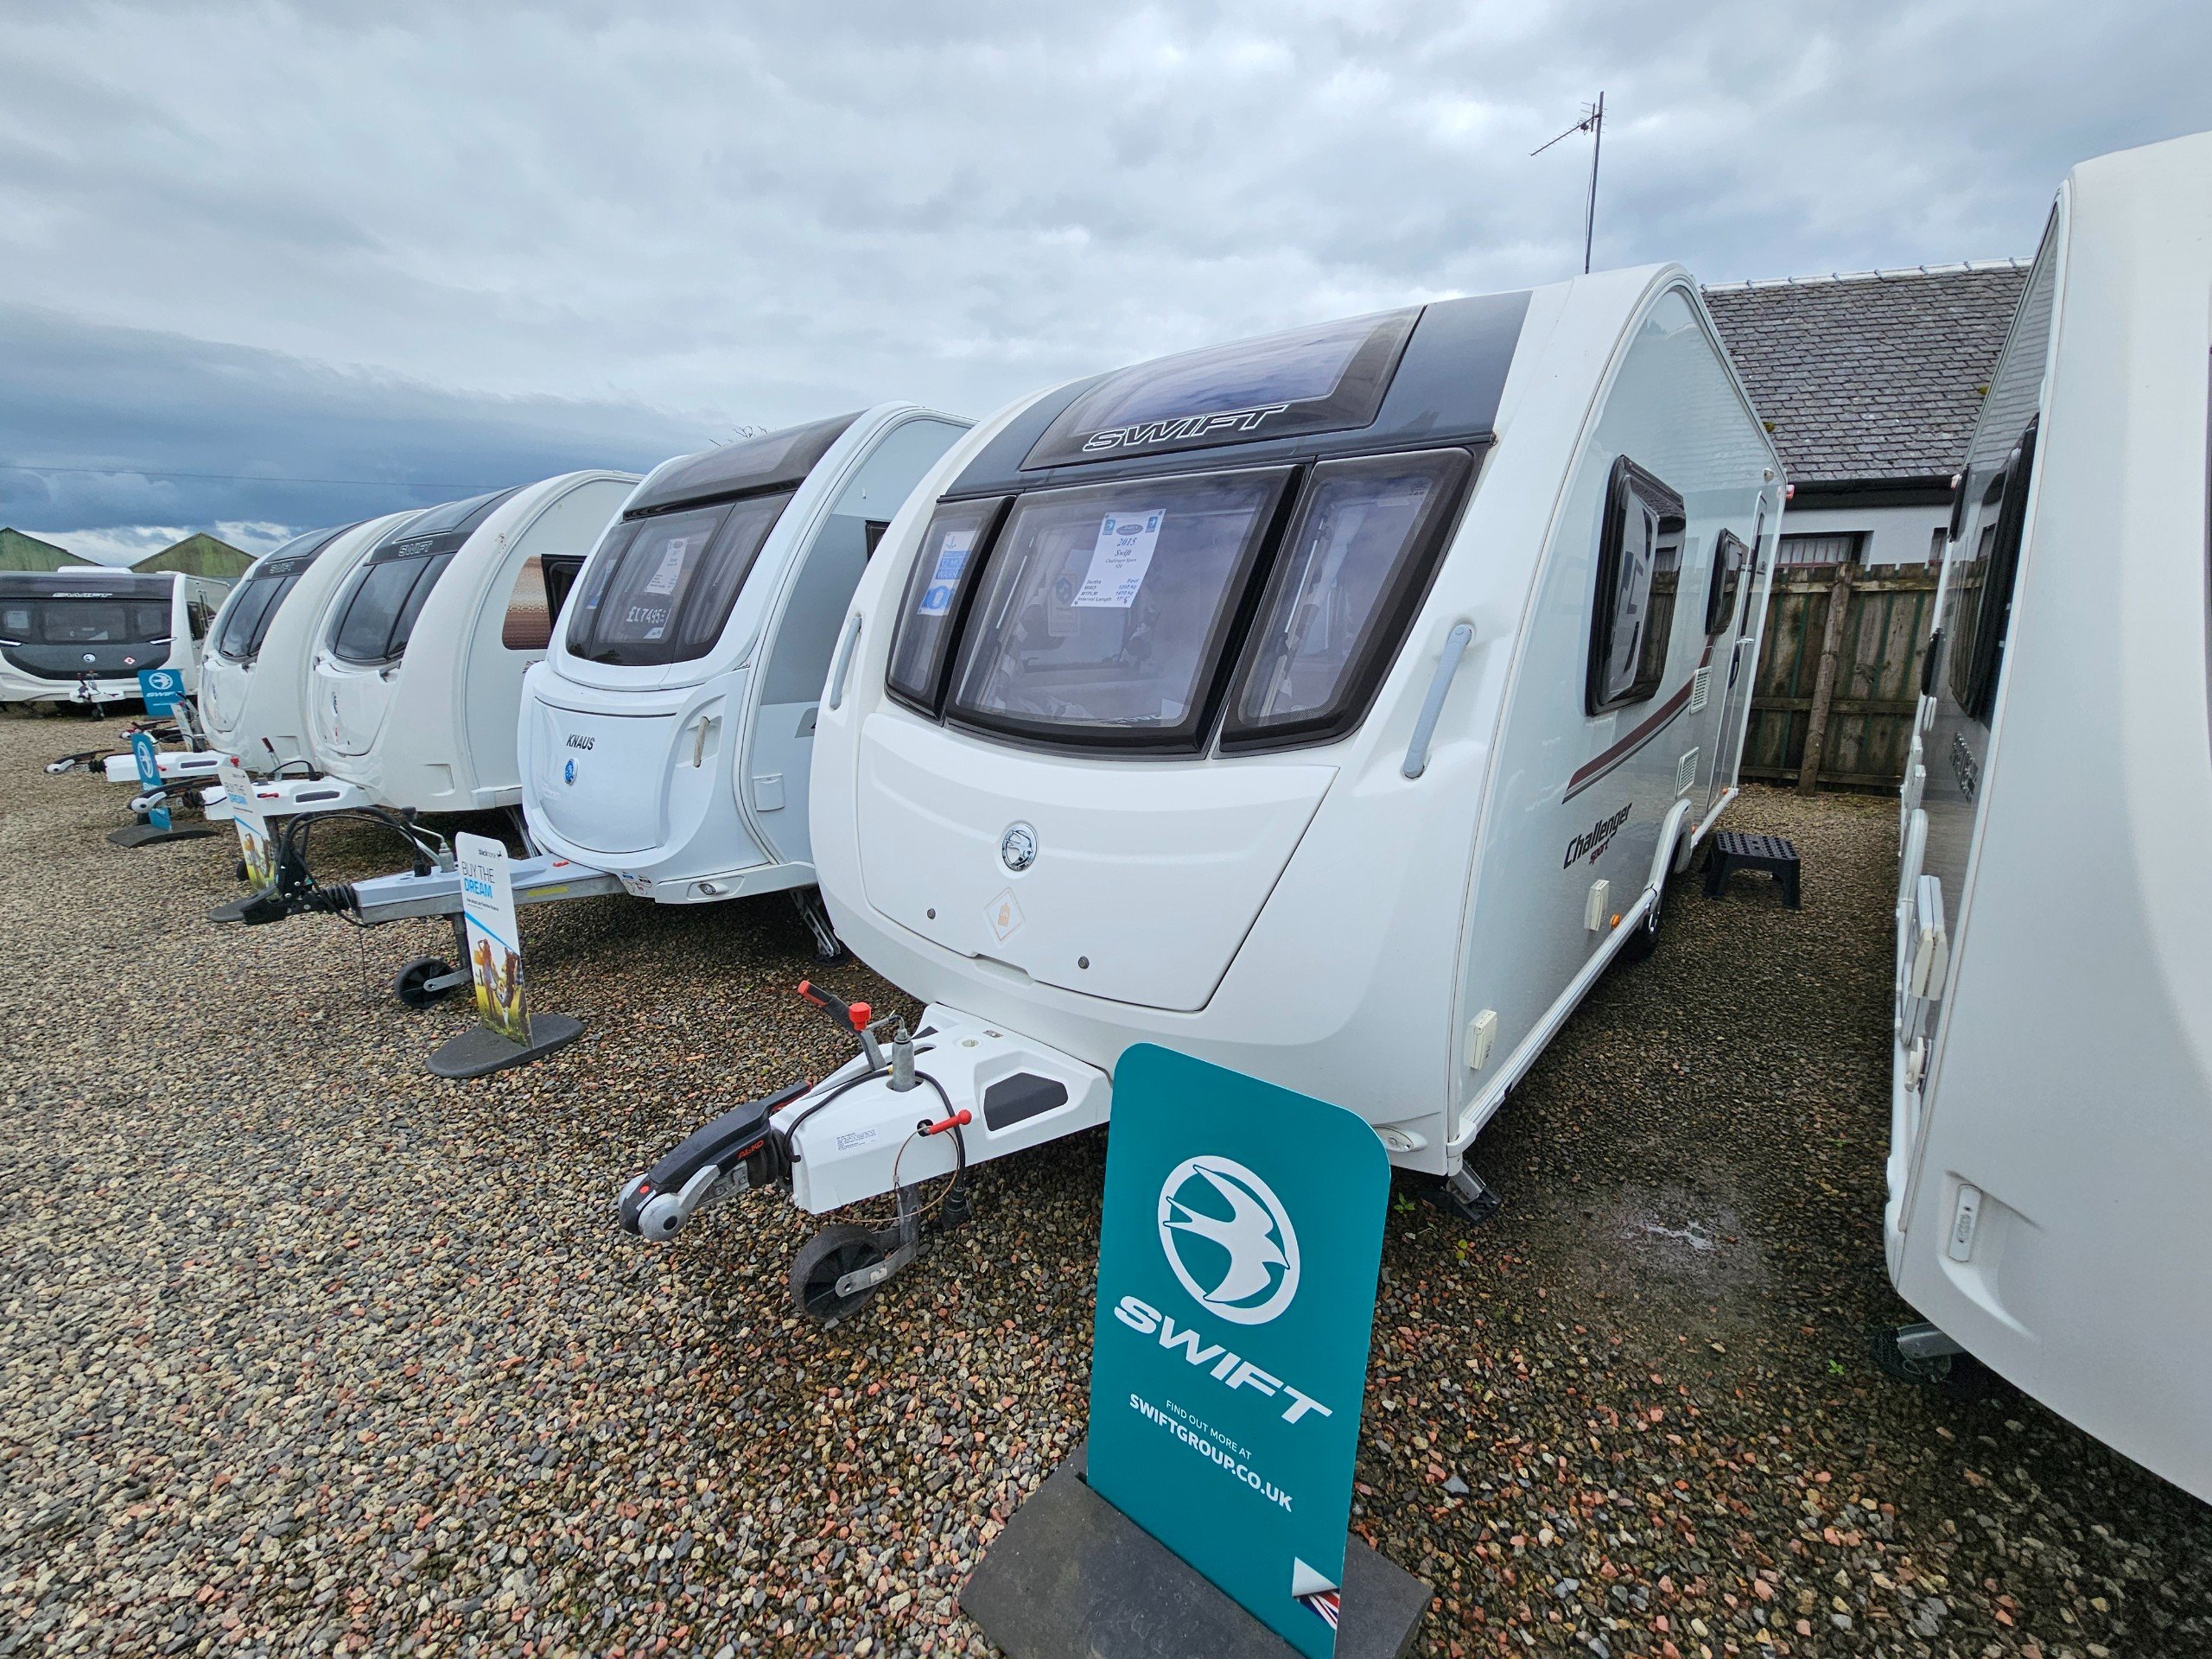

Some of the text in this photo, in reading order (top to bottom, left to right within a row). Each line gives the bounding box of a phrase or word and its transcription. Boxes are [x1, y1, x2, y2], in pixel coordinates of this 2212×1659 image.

[1083, 404, 1291, 452] SWIFT
[398, 540, 433, 556] SWIFT
[1117, 537, 1137, 546] 2015
[270, 562, 295, 575] SWIFT
[566, 734, 595, 750] KNAUS
[1564, 802, 1633, 870] Challenger
[461, 861, 495, 883] BUY THE
[464, 877, 493, 899] DREAM
[1114, 1295, 1333, 1425] SWIFT
[1166, 1399, 1252, 1460] FIND OUT MORE AT
[1129, 1393, 1293, 1512] SWIFTGROUP.CO.UK
